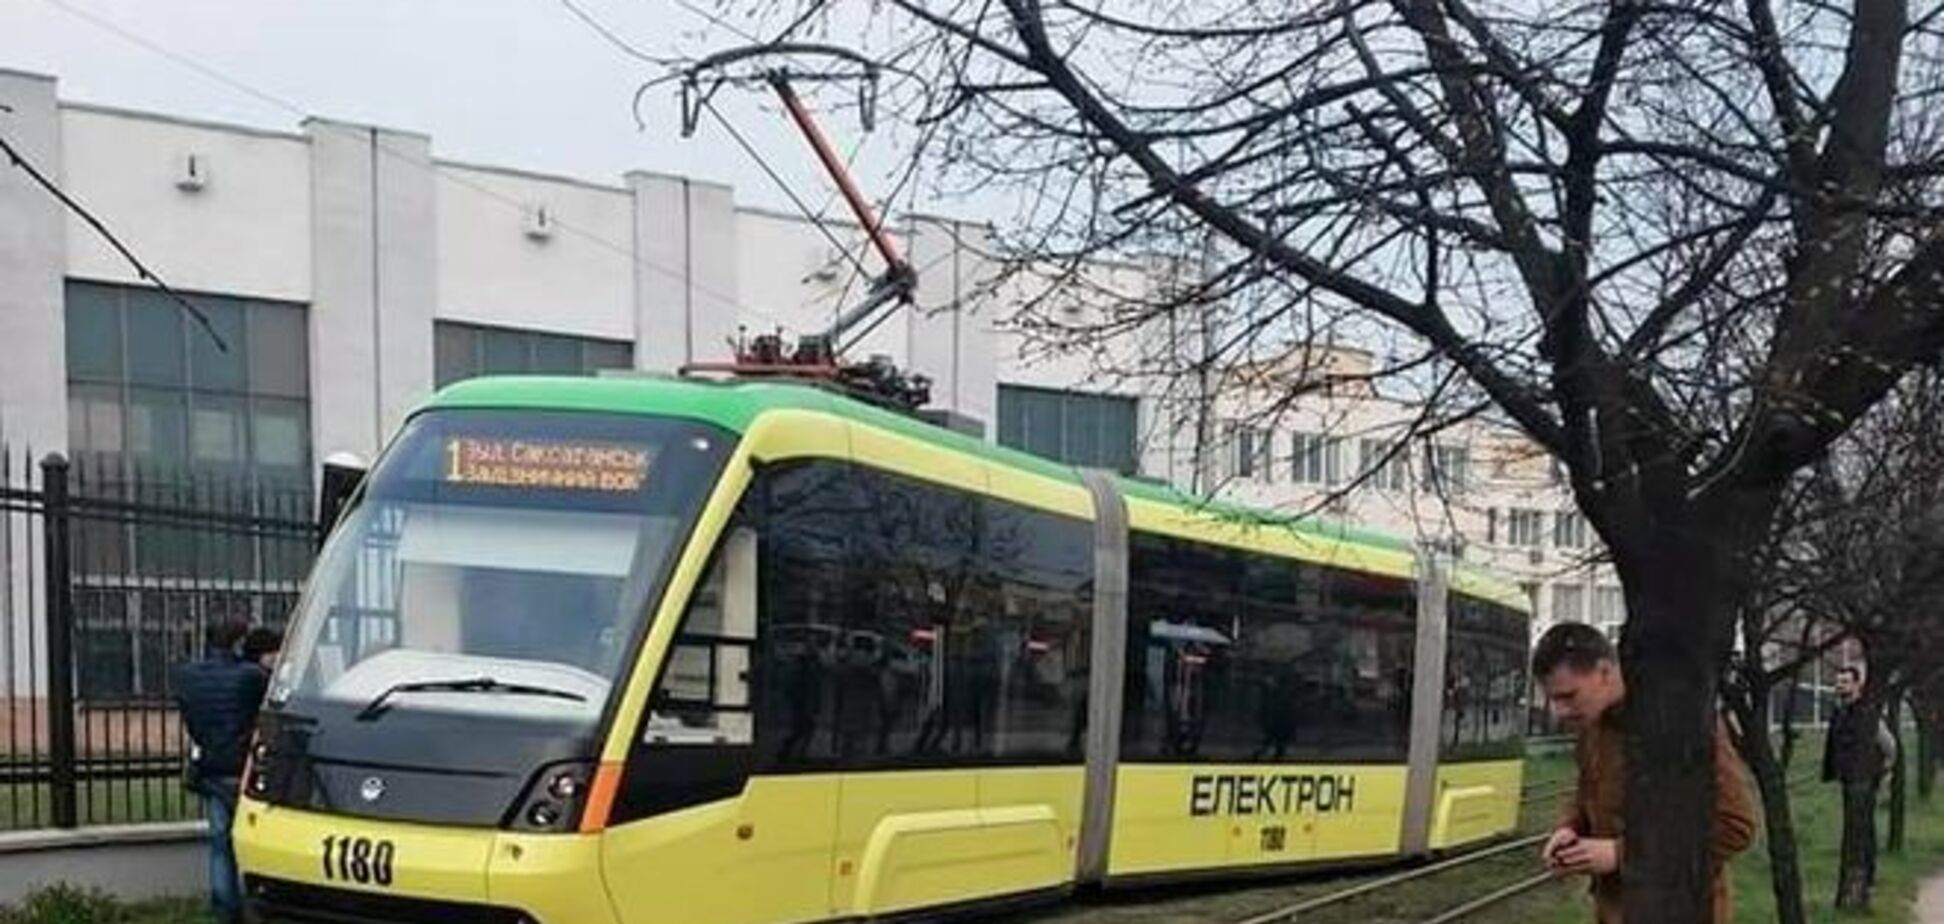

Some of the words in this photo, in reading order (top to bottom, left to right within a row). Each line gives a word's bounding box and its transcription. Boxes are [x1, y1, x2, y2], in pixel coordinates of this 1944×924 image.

[447, 439, 462, 481] 1
[1190, 774, 1356, 816] ЕЛЕКТРОН
[322, 835, 394, 887] 1180
